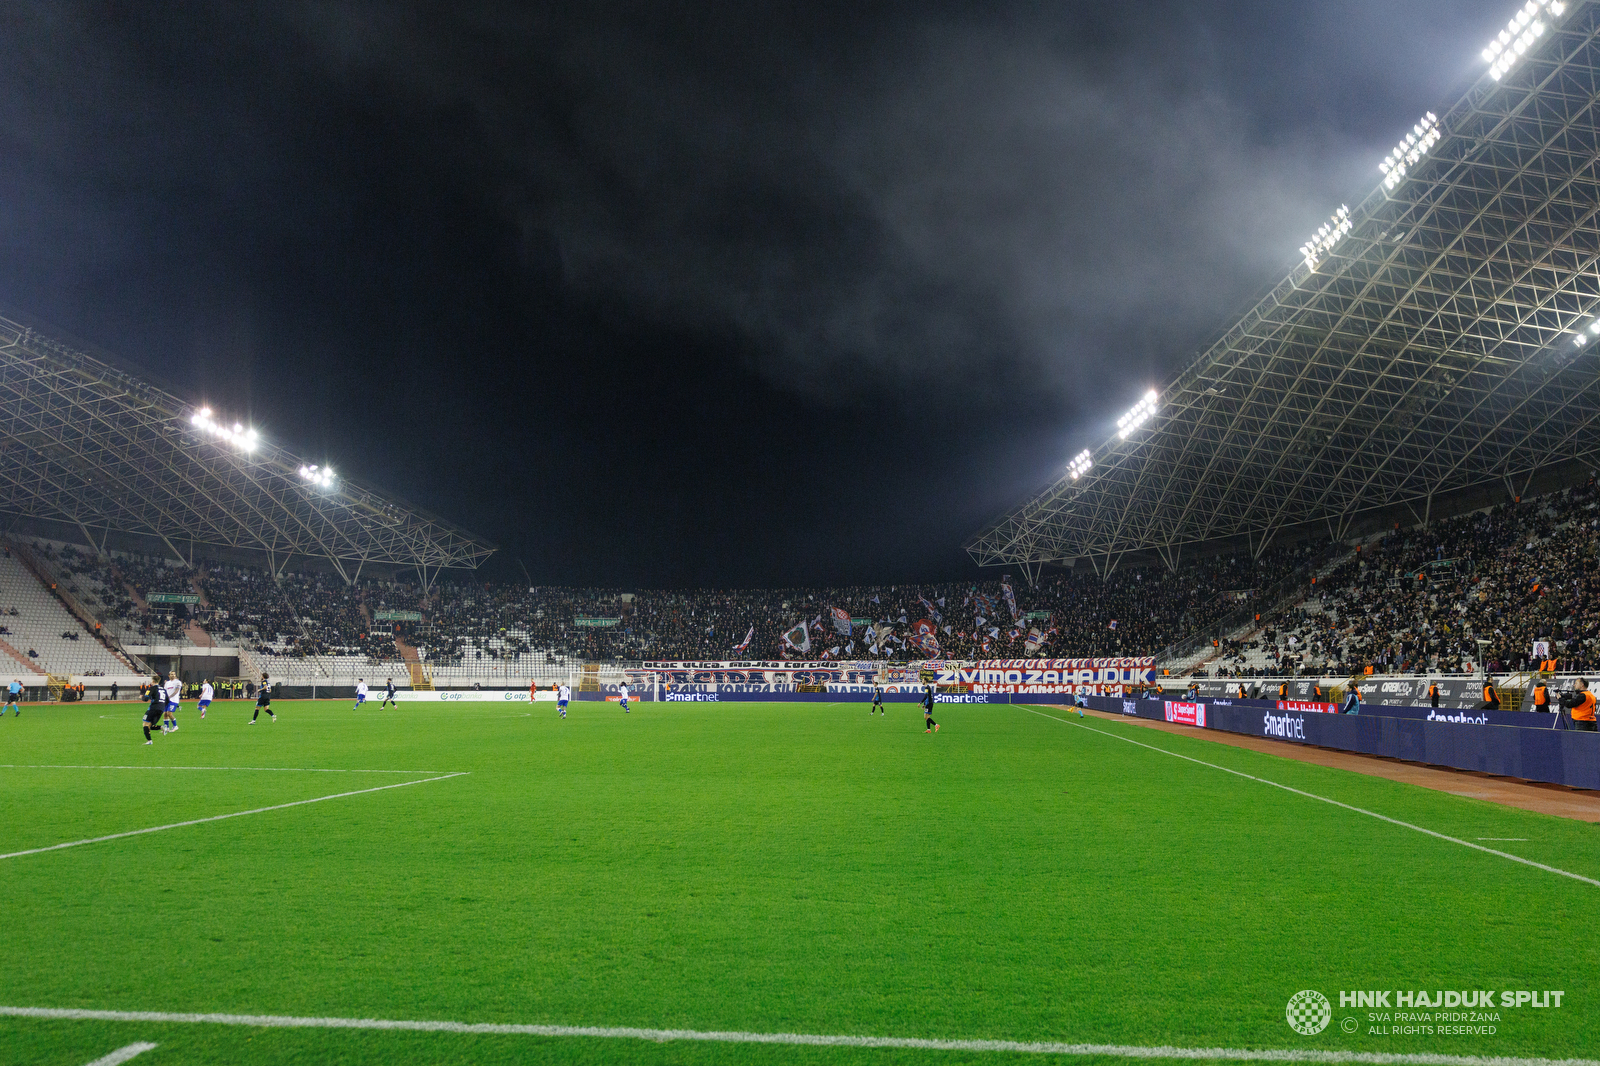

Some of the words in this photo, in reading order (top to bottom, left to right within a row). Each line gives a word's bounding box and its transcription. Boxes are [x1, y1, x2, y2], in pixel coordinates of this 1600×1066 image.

[979, 659, 1050, 669] HAJDUK
[625, 670, 769, 684] TORCIDA
[792, 671, 879, 684] SPLIT
[1025, 669, 1059, 685] ZA
[1062, 668, 1152, 685] HAJDUK
